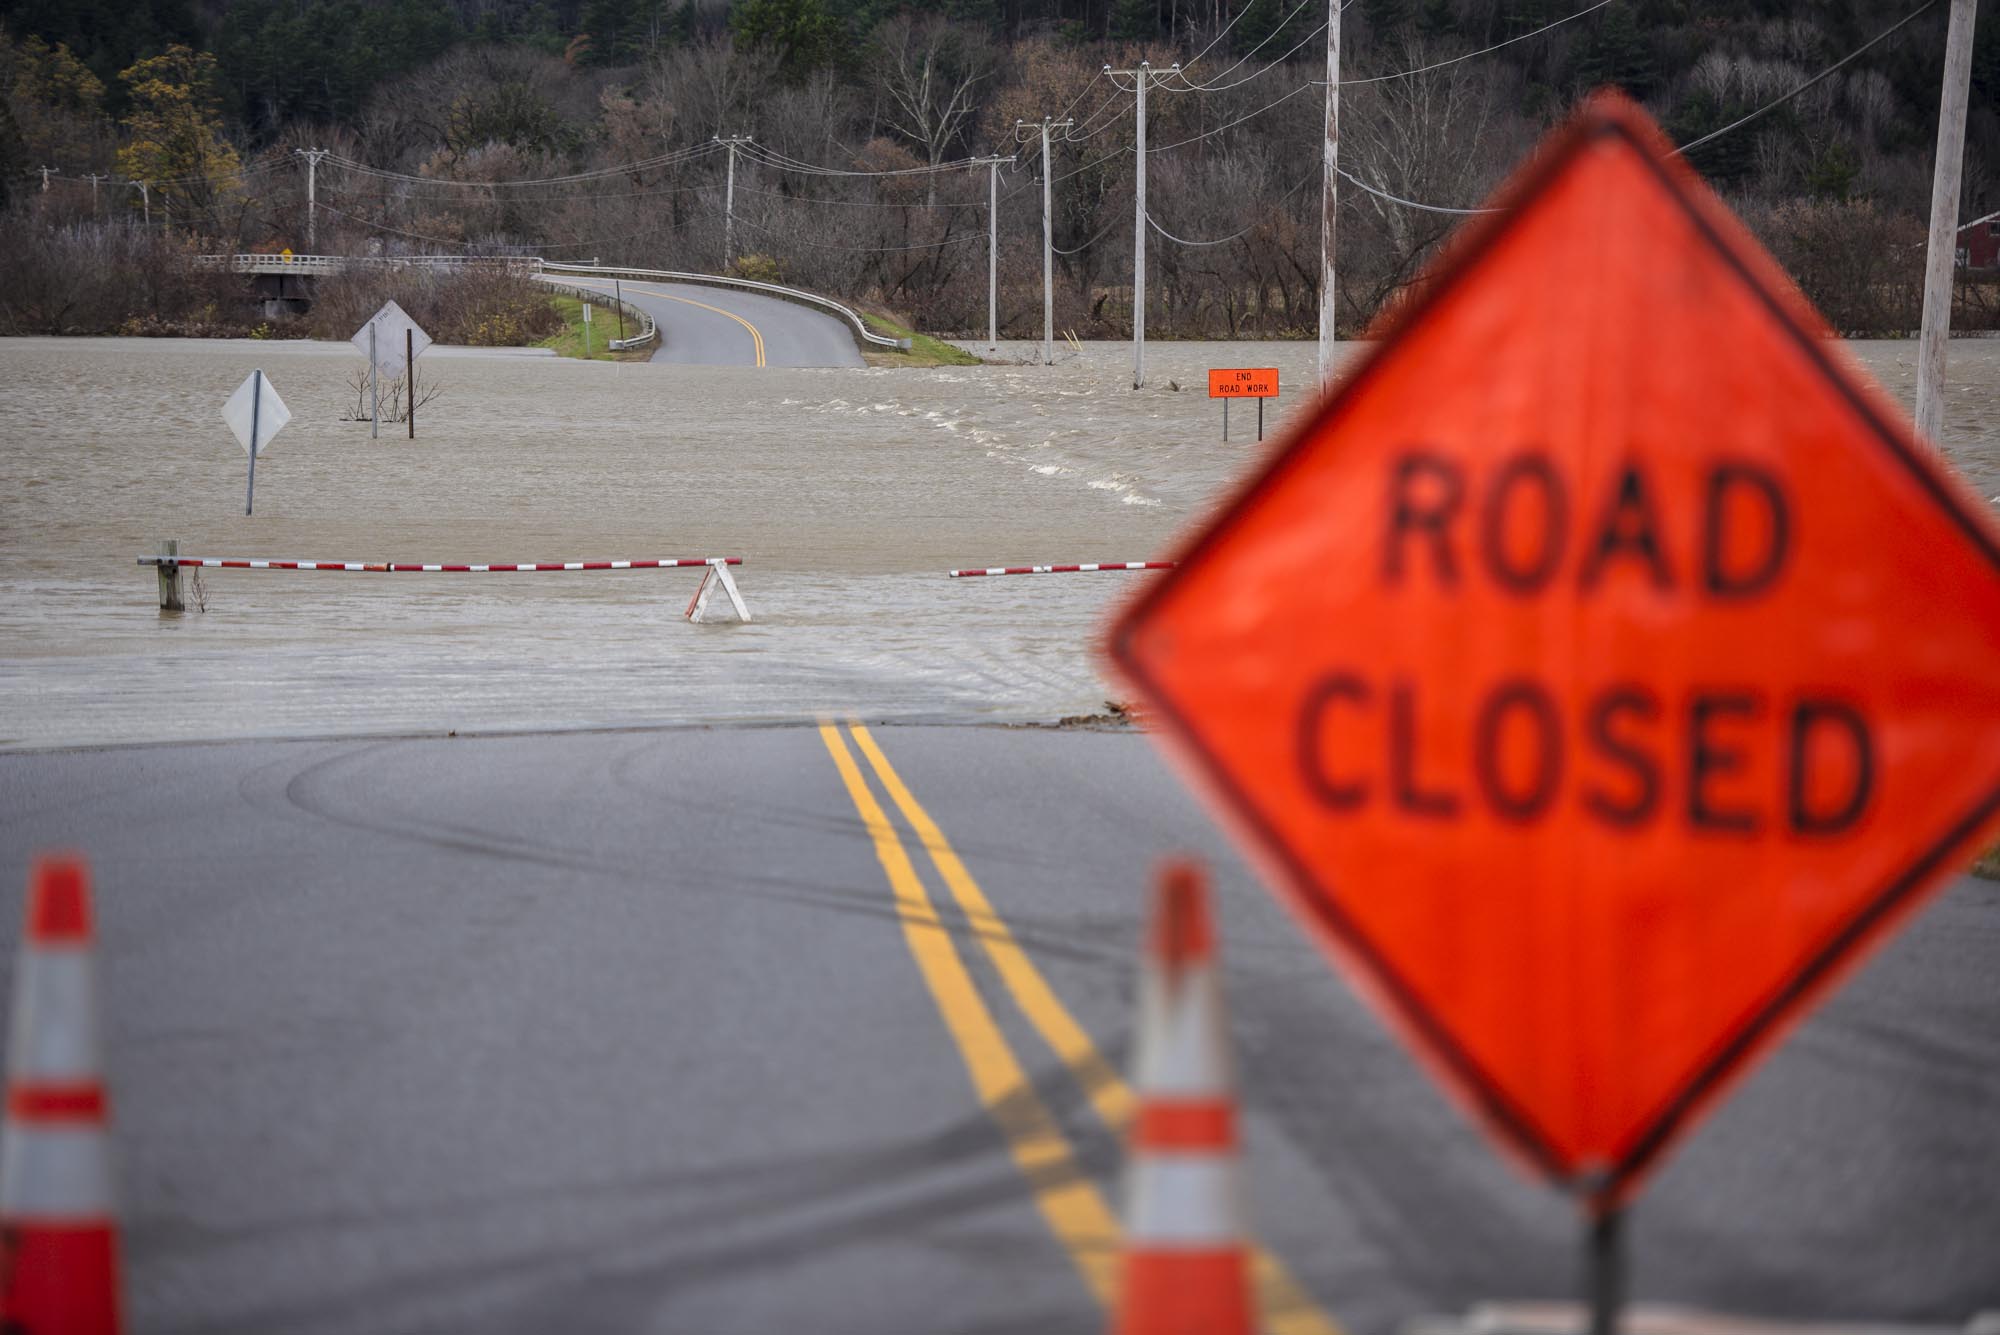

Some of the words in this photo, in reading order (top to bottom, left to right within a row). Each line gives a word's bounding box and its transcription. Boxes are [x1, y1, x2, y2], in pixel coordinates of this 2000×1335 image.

[1219, 384, 1240, 393] ROAD
[1246, 384, 1269, 393] WORK
[1236, 373, 1252, 381] END
[1385, 449, 1798, 603] ROAD
[1294, 671, 1882, 843] CLOSED
